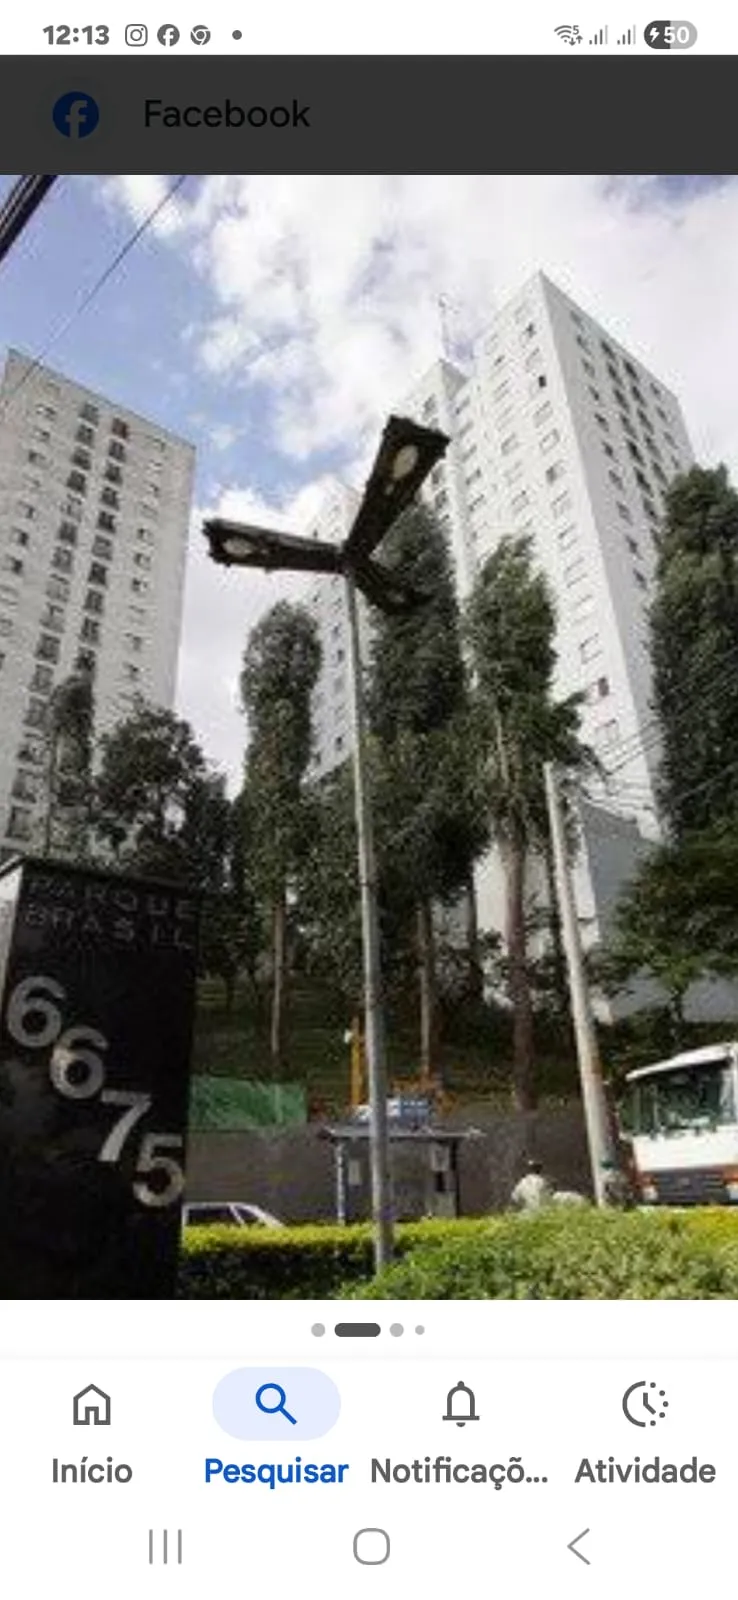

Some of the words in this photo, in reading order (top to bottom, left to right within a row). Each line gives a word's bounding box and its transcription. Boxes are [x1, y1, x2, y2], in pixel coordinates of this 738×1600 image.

[43, 24, 110, 46] 12:13
[664, 26, 690, 44] 50
[144, 99, 311, 128] Facebook
[7, 976, 186, 1207] 6675
[52, 1456, 133, 1484] Início
[205, 1456, 350, 1490] Pesquisar
[574, 1456, 717, 1484] Atividade
